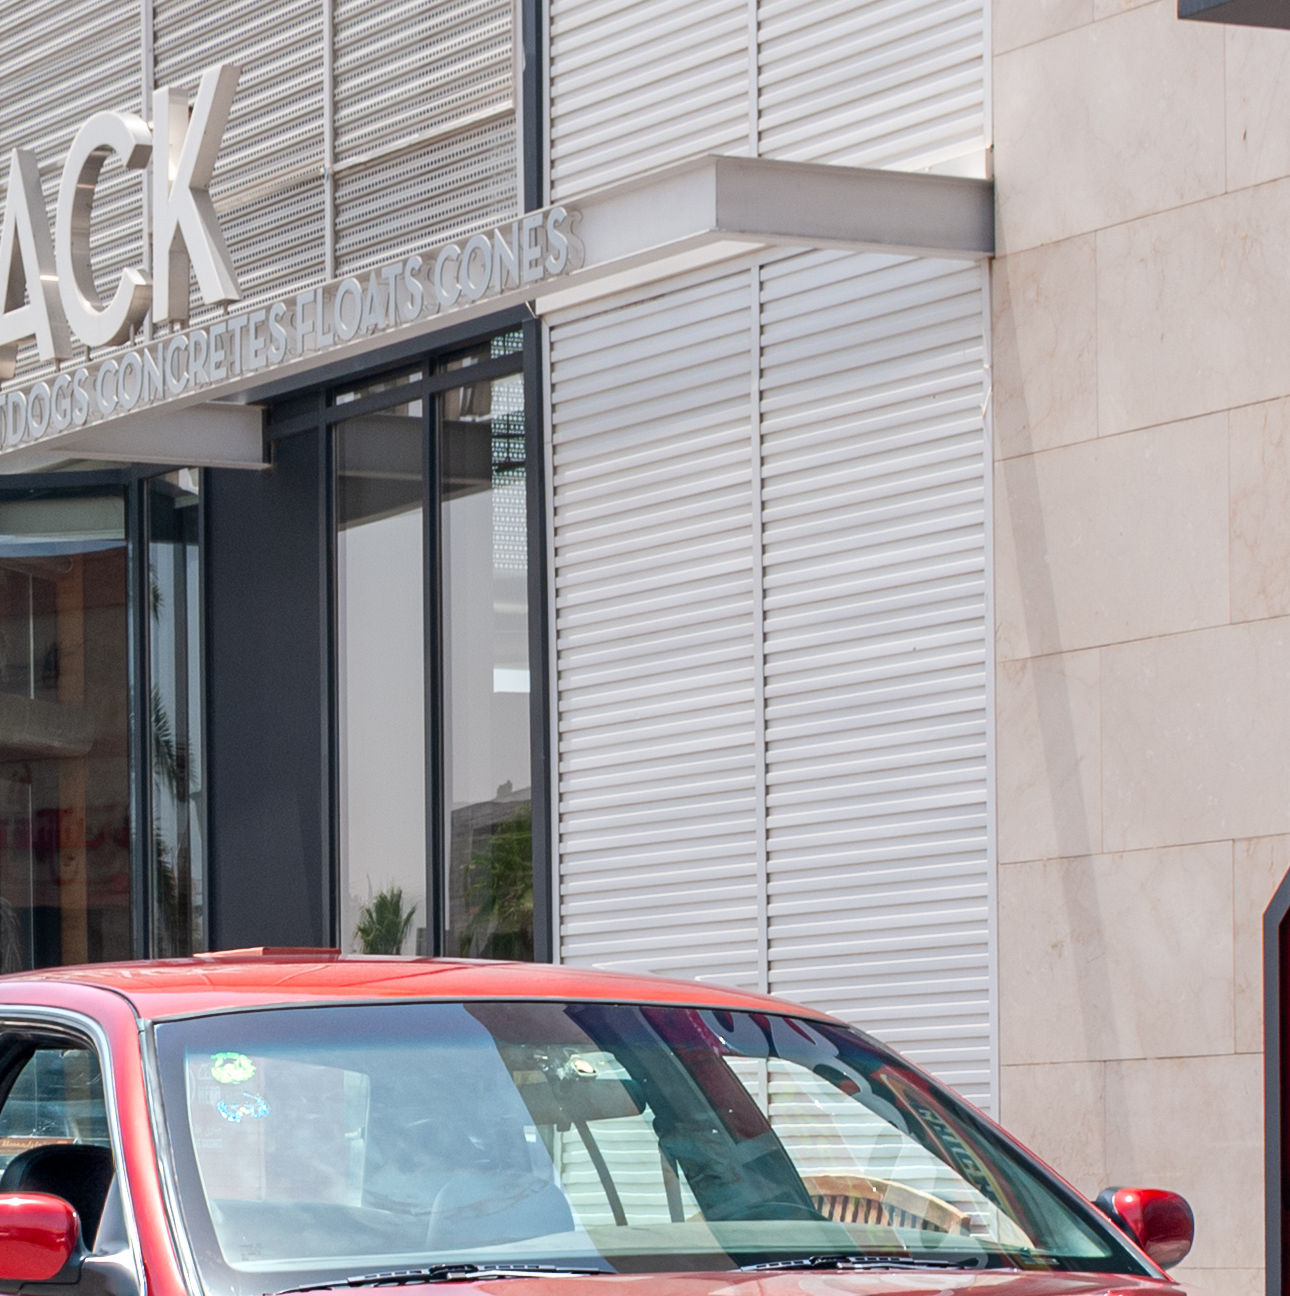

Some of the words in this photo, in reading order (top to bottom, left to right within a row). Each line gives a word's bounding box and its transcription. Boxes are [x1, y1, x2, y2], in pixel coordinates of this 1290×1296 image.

[96, 301, 288, 416] CONCRETES
[295, 254, 424, 355] FLOATS
[434, 207, 569, 307] CONES
